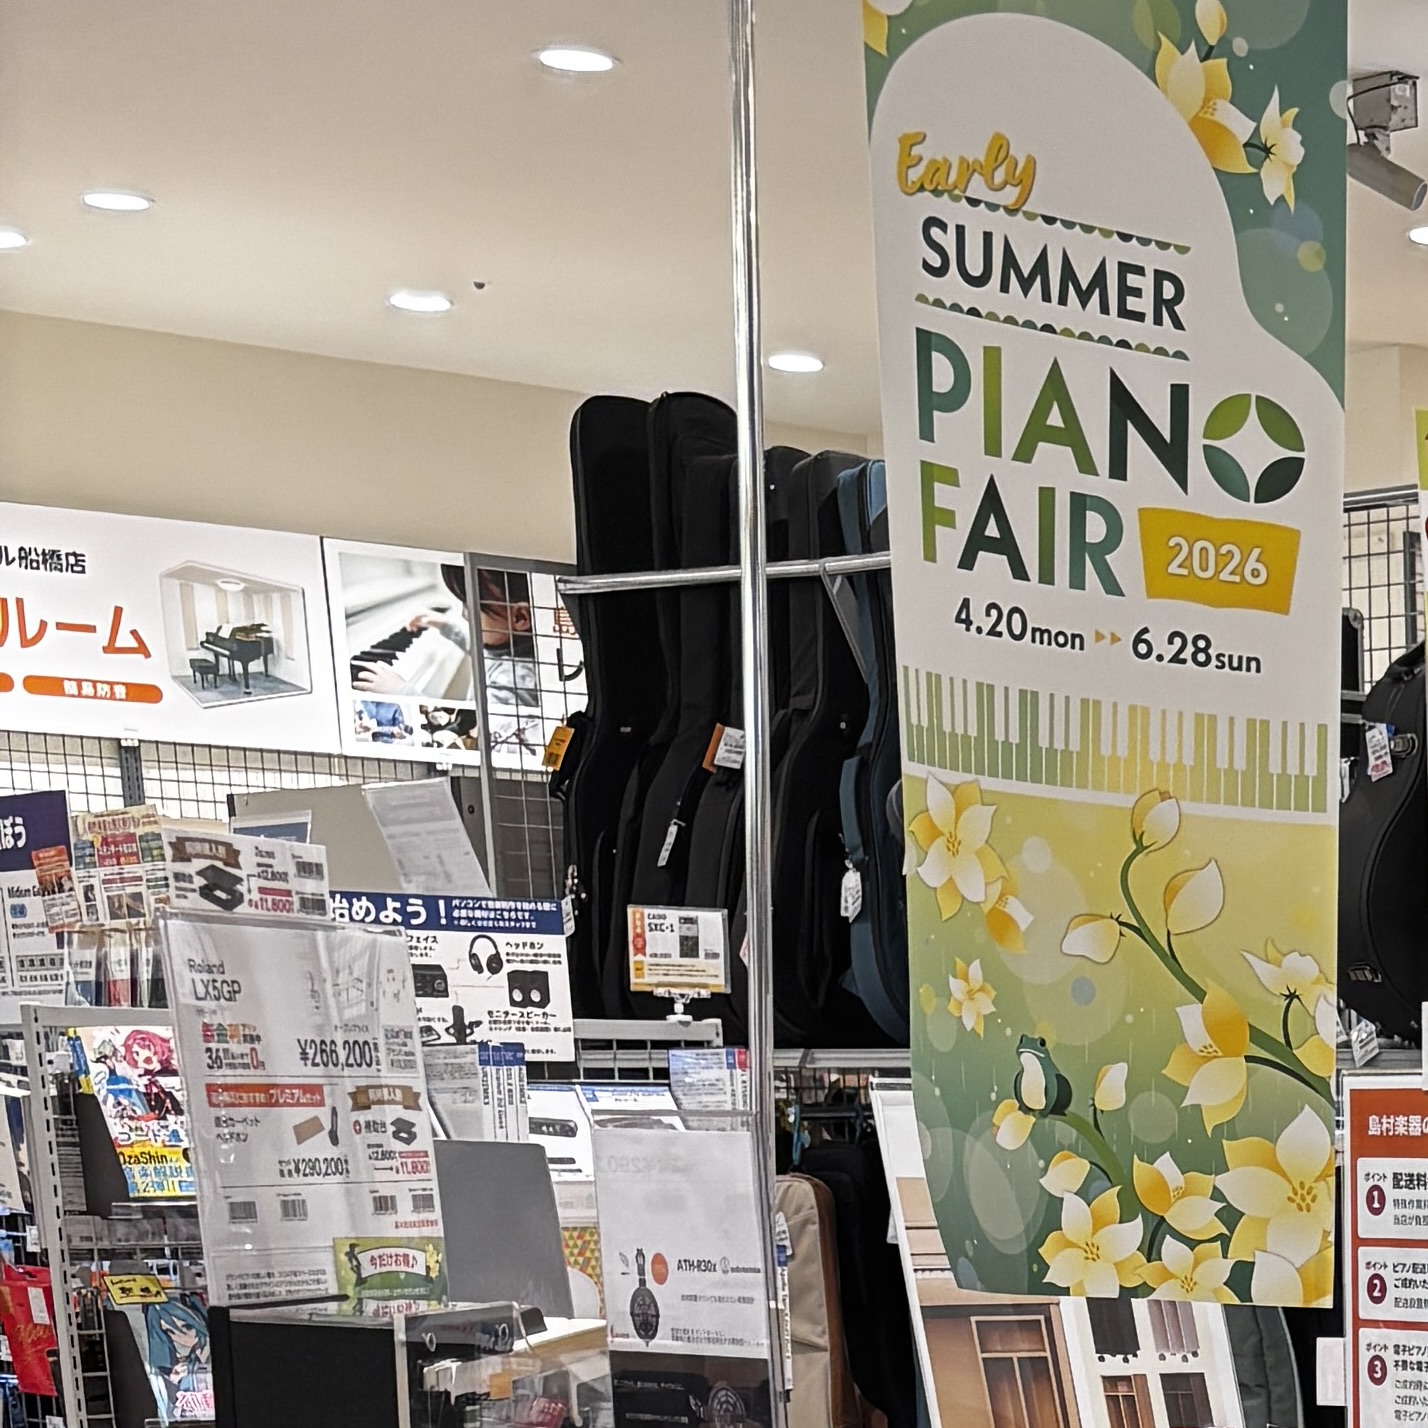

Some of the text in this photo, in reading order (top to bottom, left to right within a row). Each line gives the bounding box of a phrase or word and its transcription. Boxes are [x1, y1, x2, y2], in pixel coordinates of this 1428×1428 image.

[897, 131, 1037, 209] Early
[920, 214, 1187, 332] SUMMER
[914, 326, 1306, 505] PIANO
[918, 459, 1269, 598] FAIR 2026
[954, 597, 1262, 675] 4.20mon 6.28sun
[187, 958, 226, 976] Roland
[190, 979, 242, 1003] LX5GP
[297, 1037, 373, 1072] ¥266,200
[1364, 1171, 1387, 1182] ポイント
[1372, 1190, 1380, 1209] 1
[1365, 1260, 1388, 1271] ポイント
[1372, 1279, 1382, 1297] 2
[1366, 1342, 1389, 1352] ポイント
[1373, 1360, 1383, 1379] 3
